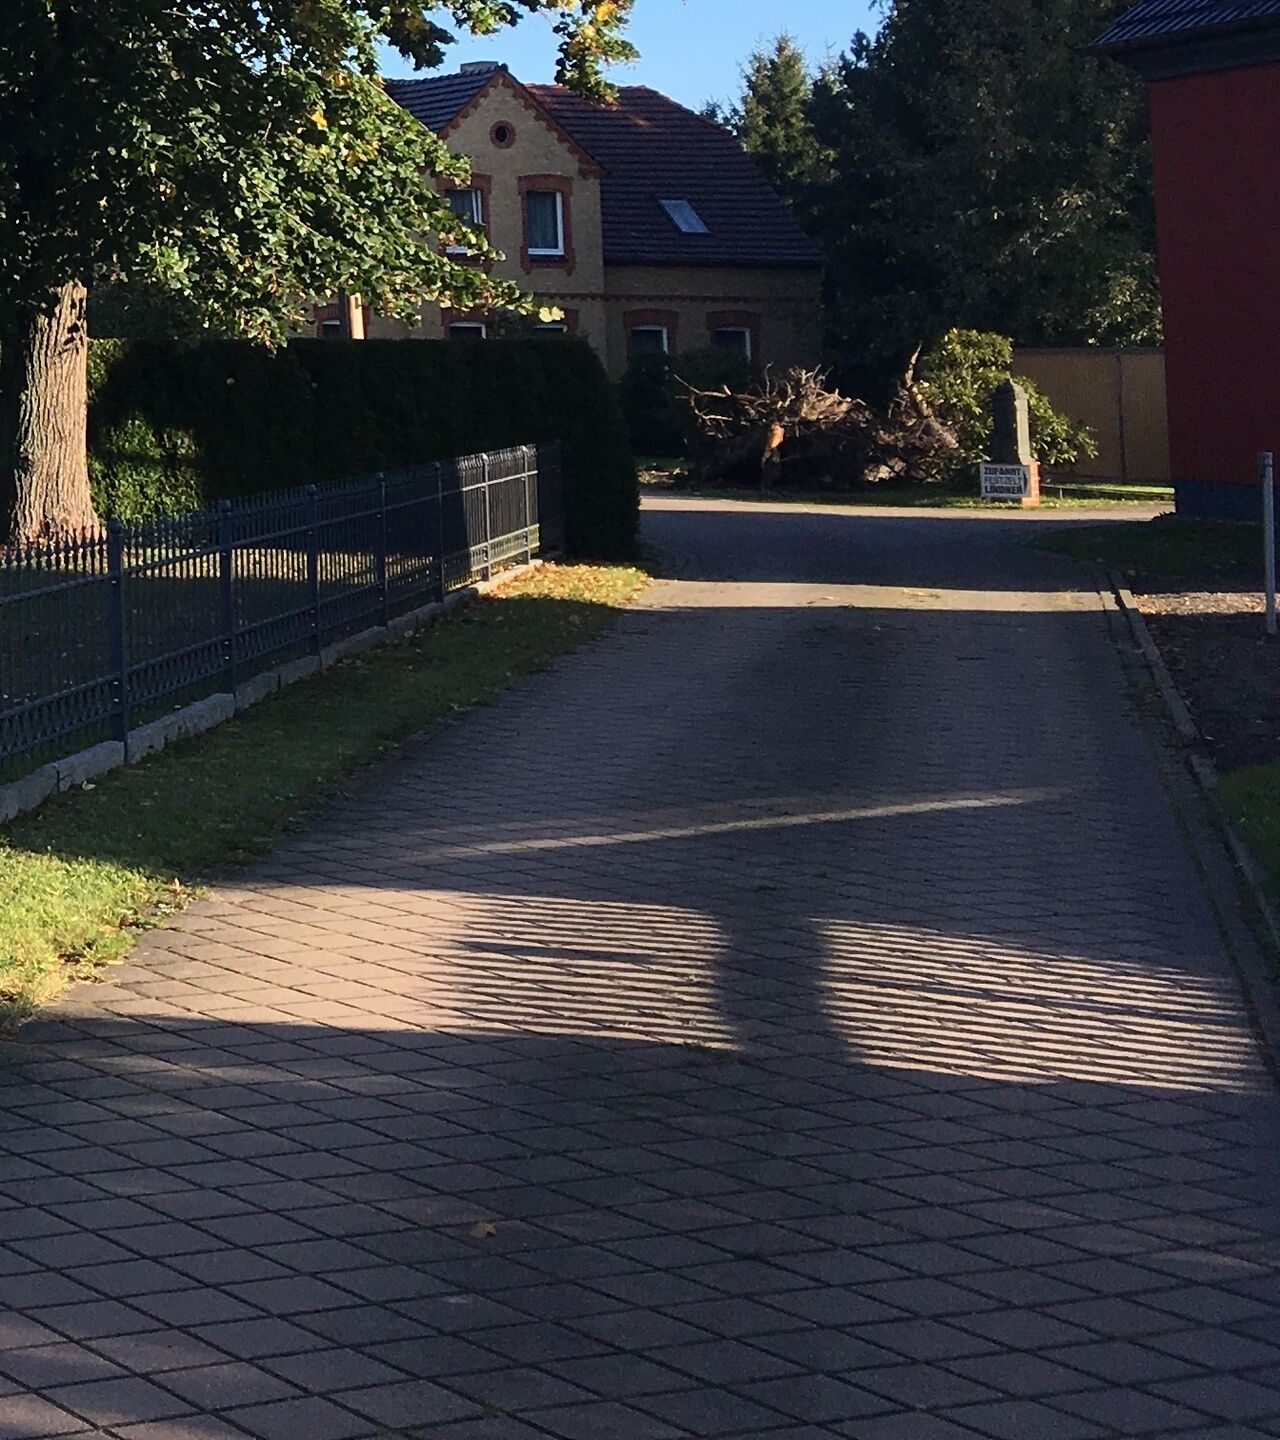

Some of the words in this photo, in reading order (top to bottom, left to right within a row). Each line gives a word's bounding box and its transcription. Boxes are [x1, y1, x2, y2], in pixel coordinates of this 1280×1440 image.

[984, 467, 1021, 476] ZUFAHRT
[984, 476, 1021, 485] FESTZELT
[985, 485, 1023, 494] LINDNER
